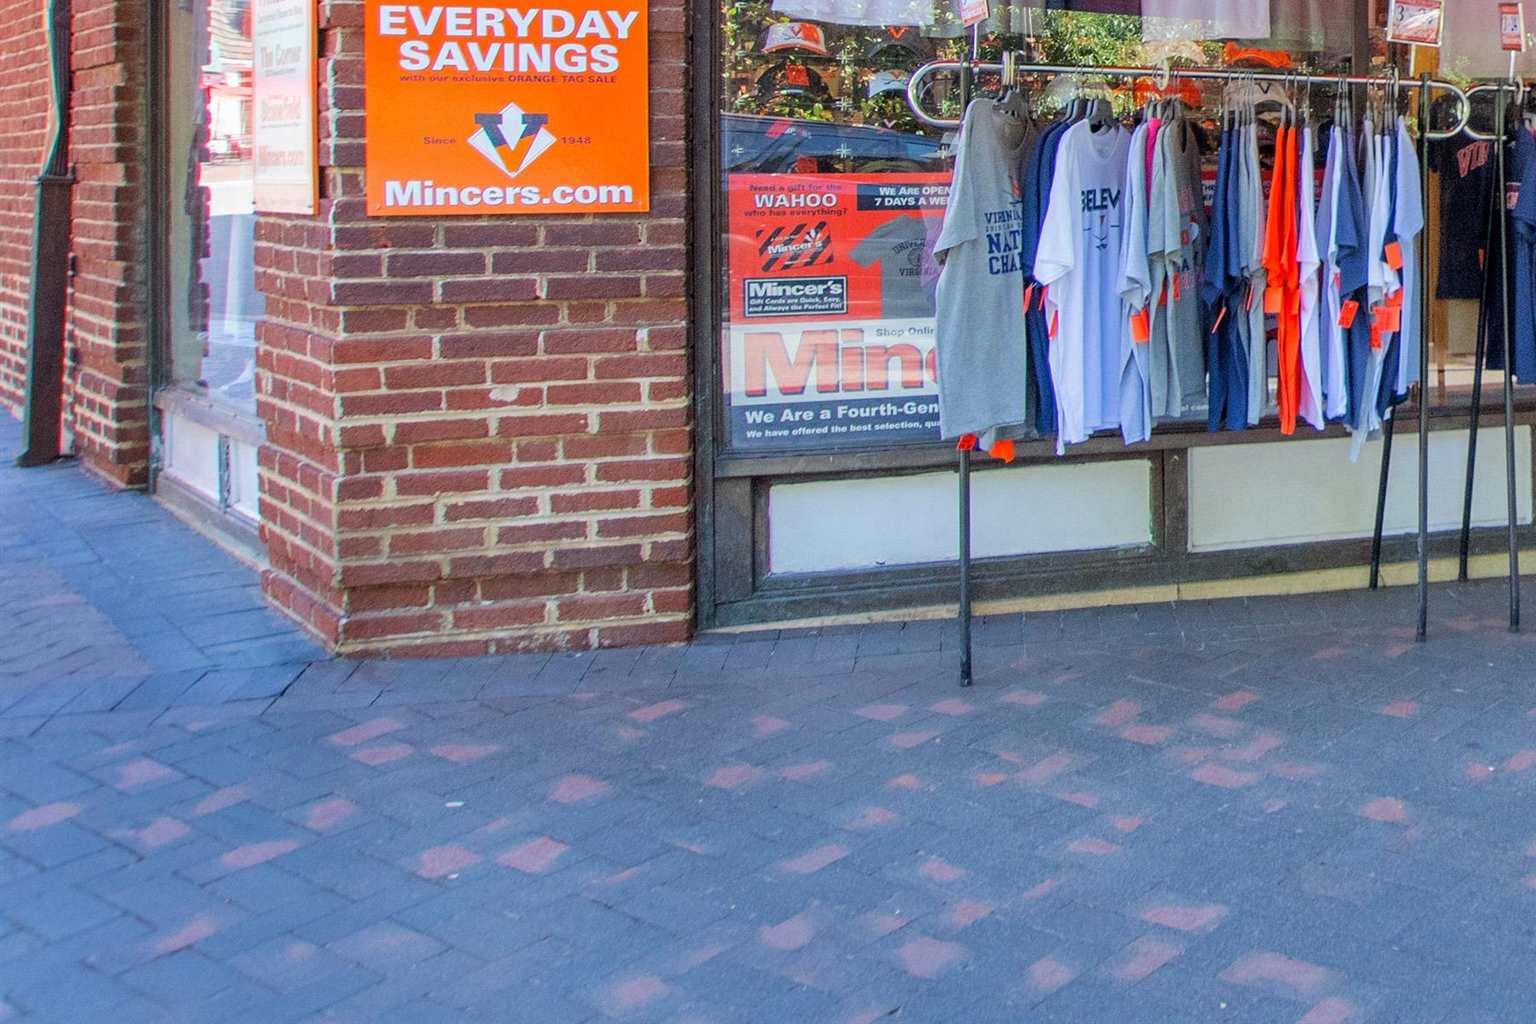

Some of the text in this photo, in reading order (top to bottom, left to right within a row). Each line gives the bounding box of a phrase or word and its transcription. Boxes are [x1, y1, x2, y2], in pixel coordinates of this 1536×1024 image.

[378, 5, 639, 40] EVERYDAY
[399, 41, 620, 74] SAVINGS
[423, 136, 457, 145] Since
[560, 136, 592, 145] 1948
[384, 179, 633, 208] Mincers.com
[787, 184, 805, 193] gift
[879, 186, 950, 195] WE ARE OPEN
[754, 193, 837, 208] WAHOO
[884, 197, 915, 206] DAYS
[918, 197, 928, 205] A
[790, 208, 848, 218] everything?
[768, 240, 823, 254] Mincer's
[749, 279, 843, 298] Mincer's
[764, 305, 789, 313] Always
[876, 328, 904, 337] Shop
[745, 410, 774, 424] We
[780, 409, 814, 422] Are
[819, 409, 831, 419] a
[745, 421, 922, 438] We have offered the best selection,
